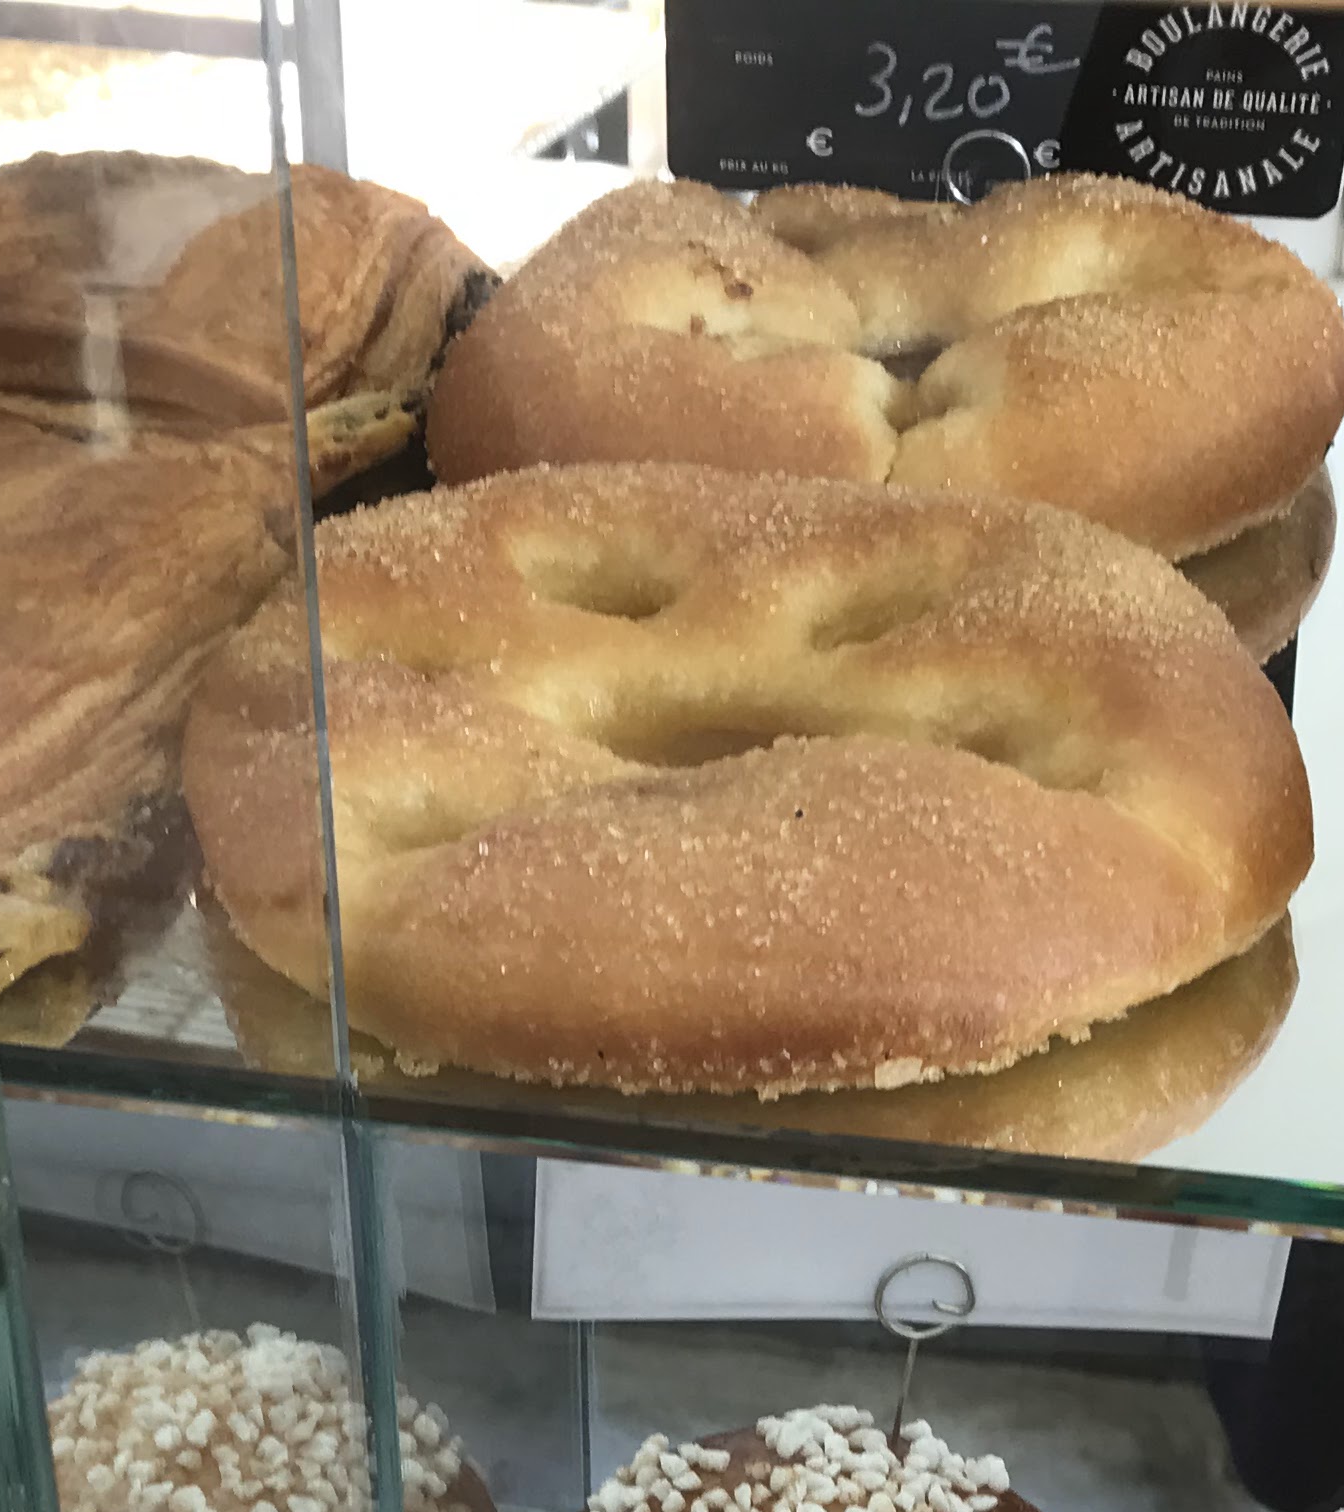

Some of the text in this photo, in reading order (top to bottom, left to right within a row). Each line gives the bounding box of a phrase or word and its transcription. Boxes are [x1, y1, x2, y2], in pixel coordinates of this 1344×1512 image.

[1124, 1, 1331, 81] BOULANGERIE
[1205, 68, 1244, 84] PAINS
[1123, 83, 1205, 110] ARTISAN
[1212, 88, 1235, 111] DE
[1195, 115, 1267, 132] TRADITION
[1114, 119, 1321, 199] ARTISANALE
